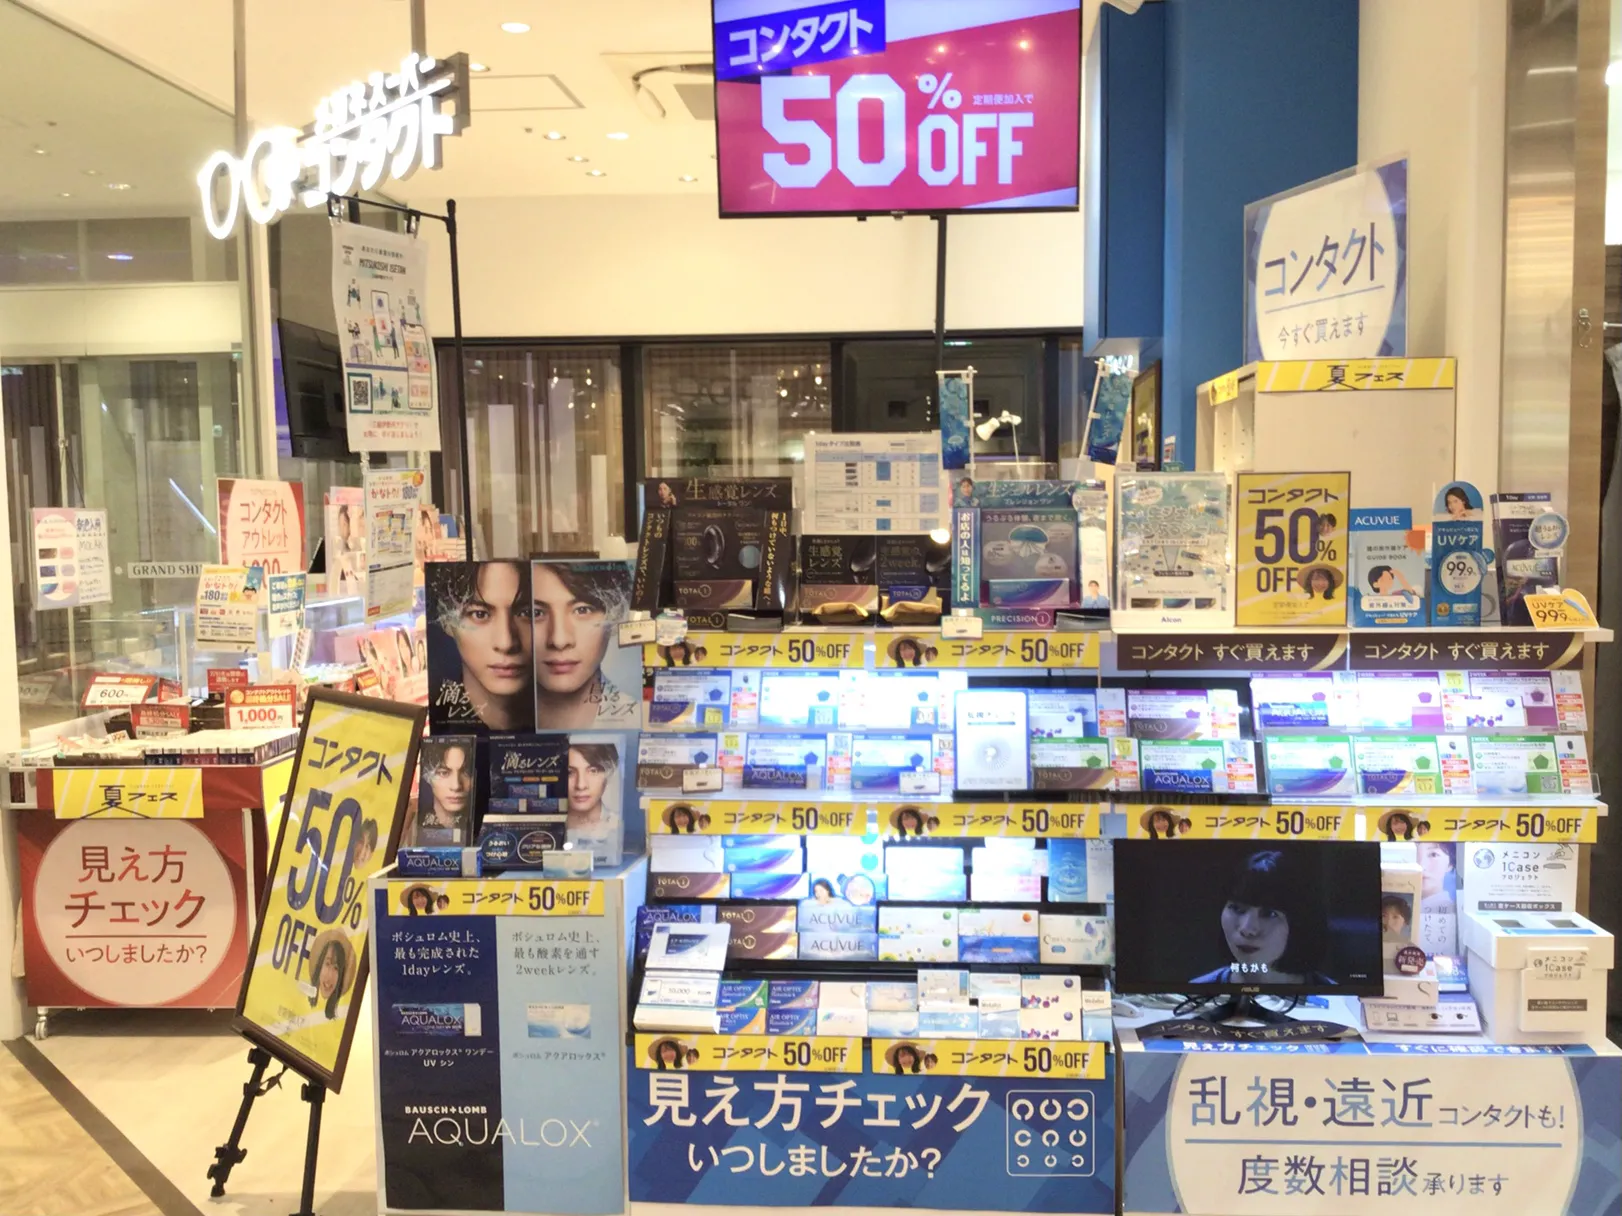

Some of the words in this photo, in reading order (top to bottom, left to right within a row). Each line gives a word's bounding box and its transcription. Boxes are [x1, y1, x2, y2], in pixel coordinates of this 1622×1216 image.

[729, 8, 873, 67] コンタクト
[973, 94, 1034, 105] 定期便加入で
[917, 112, 1034, 187] OFF
[1264, 222, 1385, 296] コンタクト
[1278, 313, 1368, 349] 今すぐ買えます
[1322, 364, 1404, 389] 夏フェス
[1248, 488, 1339, 504] コンタクト
[240, 498, 288, 525] コンタクト
[1354, 515, 1400, 526] ACUVUE
[242, 527, 288, 549] アウトレット
[1437, 535, 1478, 546] UVケア
[132, 564, 176, 576] GRAND
[179, 564, 203, 576] SHI
[1257, 566, 1299, 593] OFF
[1532, 601, 1564, 609] UVケア
[1161, 616, 1182, 624] Alcon
[720, 645, 783, 657] コンタクト
[787, 638, 850, 663] 50%OFF
[951, 644, 1016, 657] コンタクト
[1020, 638, 1085, 663] 50%OFF
[1131, 643, 1204, 661] コンタクト
[1212, 643, 1314, 662] すぐ買えます
[1364, 642, 1439, 661] コンタクト
[1448, 641, 1550, 661] すぐ買えます
[447, 702, 489, 718] レンズ
[596, 701, 638, 716] レンズ
[307, 735, 393, 785] コンタクト
[501, 751, 560, 770] 滴るレンズ
[1154, 775, 1210, 785] AQUALOX
[98, 783, 178, 810] 夏フェス
[724, 811, 787, 824] コンタクト
[791, 807, 854, 831] 50%OFF
[953, 814, 1017, 827] コンタクト
[1022, 808, 1086, 833] 50%OFF
[1205, 816, 1271, 828] コンタクト
[1276, 810, 1342, 835] 50%OFF
[1444, 818, 1511, 831] コンタクト
[1516, 812, 1582, 838] 50%OFF
[78, 844, 188, 884] 見え方
[406, 857, 459, 868] AQUALOX
[1502, 851, 1541, 859] メニコン
[1502, 861, 1540, 873] 1Case
[462, 892, 524, 904] コンタクト
[529, 886, 591, 911] 50%OFF
[64, 889, 206, 929] チェック
[645, 912, 698, 922] AQUALOX
[809, 912, 862, 925] ACUVUE
[66, 943, 208, 964] いつしましたか?
[271, 912, 319, 981] OFF
[394, 946, 480, 960] 最も完成された
[513, 946, 600, 960] 最も酸素を通す
[810, 939, 864, 951] ACUVUE
[402, 963, 473, 977] 1dayレンズ。
[515, 963, 597, 977] 2weekレンズ。
[1230, 962, 1269, 974] 何もかも
[1544, 963, 1573, 972] 1Case
[401, 1015, 461, 1026] AQUALOX
[465, 1049, 494, 1057] ワンデー
[713, 1046, 778, 1060] コンタクト
[783, 1041, 847, 1066] 50%OFF
[1183, 1041, 1300, 1052] 見え方チェック
[423, 1059, 437, 1067] UV
[951, 1051, 1018, 1064] コンタクト
[1023, 1046, 1090, 1073] 50%OFF
[404, 1105, 488, 1114] BAUSCH+LOMB
[643, 1072, 990, 1132] 見え方チェック
[408, 1117, 592, 1148] AQUALOX
[688, 1143, 942, 1179] いつしましたか?
